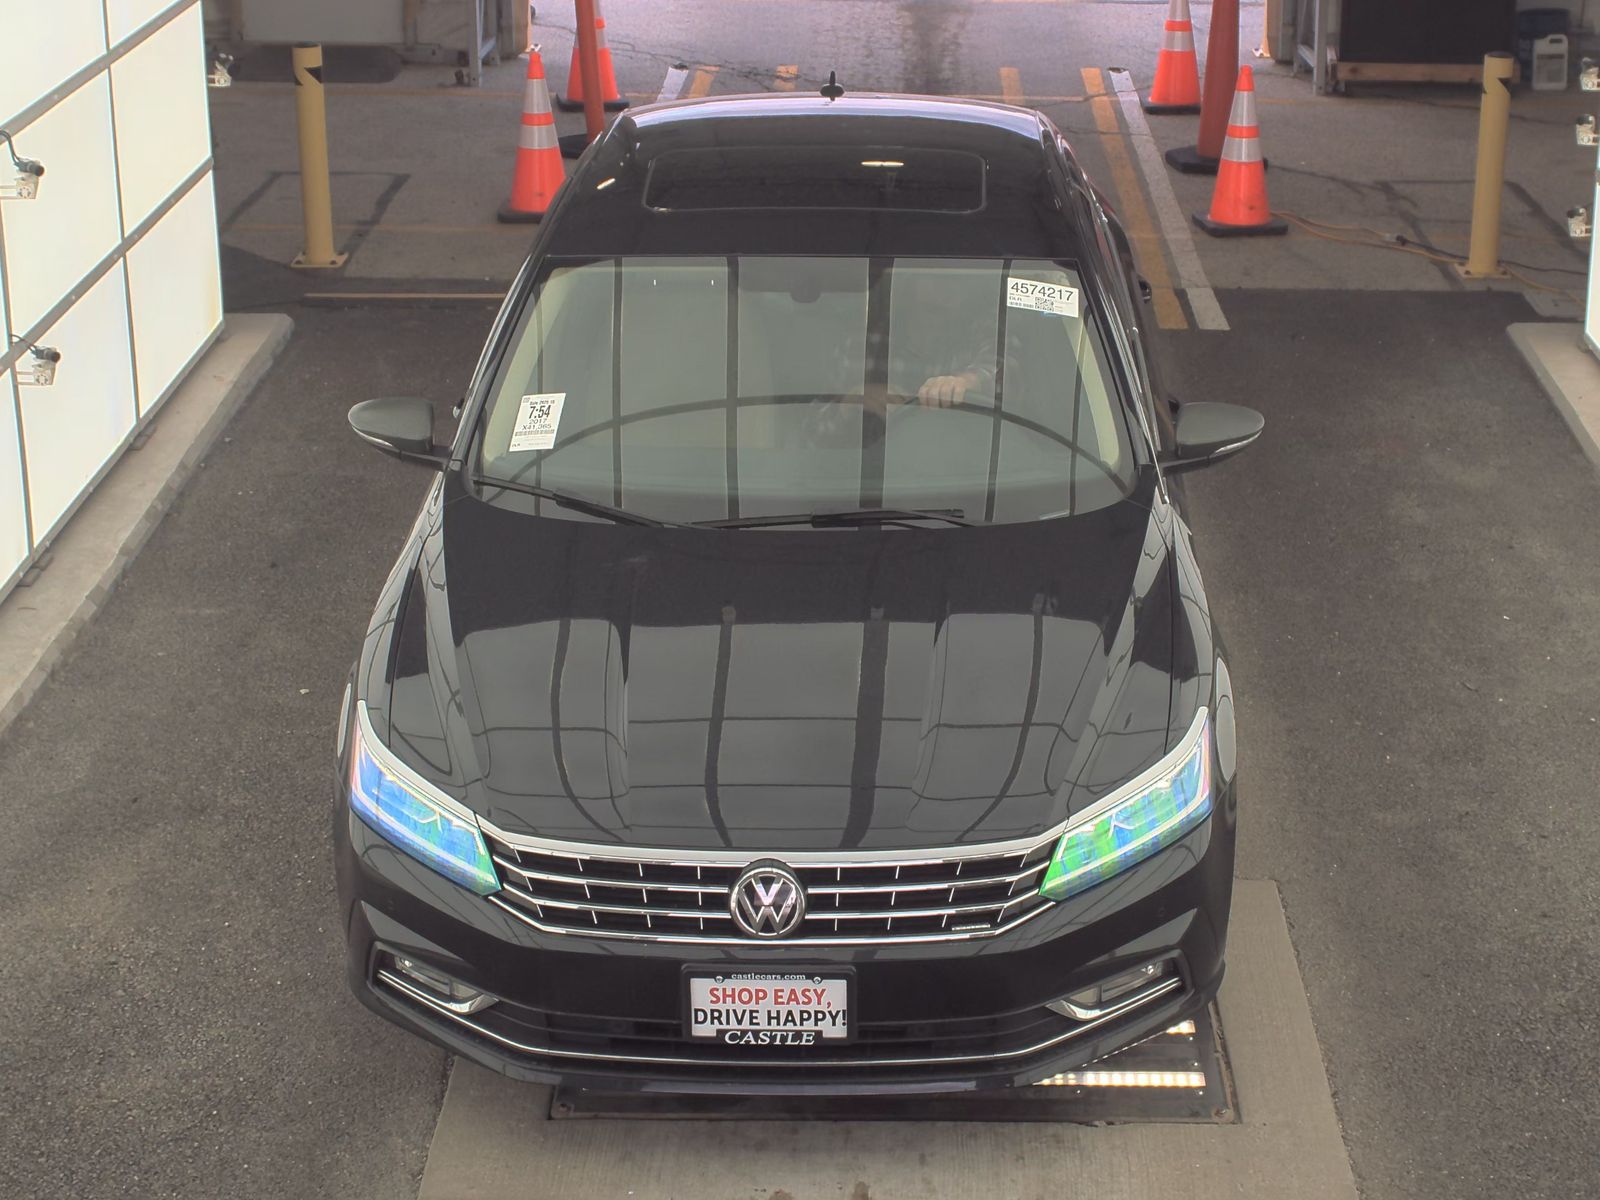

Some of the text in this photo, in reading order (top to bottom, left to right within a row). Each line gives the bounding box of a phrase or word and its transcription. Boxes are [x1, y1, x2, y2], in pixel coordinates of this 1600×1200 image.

[1011, 282, 1073, 301] 4574217
[529, 404, 551, 419] 7:54
[731, 972, 806, 981] castlecars.com
[708, 987, 832, 1008] SHOP EASY,
[693, 1008, 848, 1027] DRIVE HAPPY!
[724, 1030, 815, 1045] CASTLE
